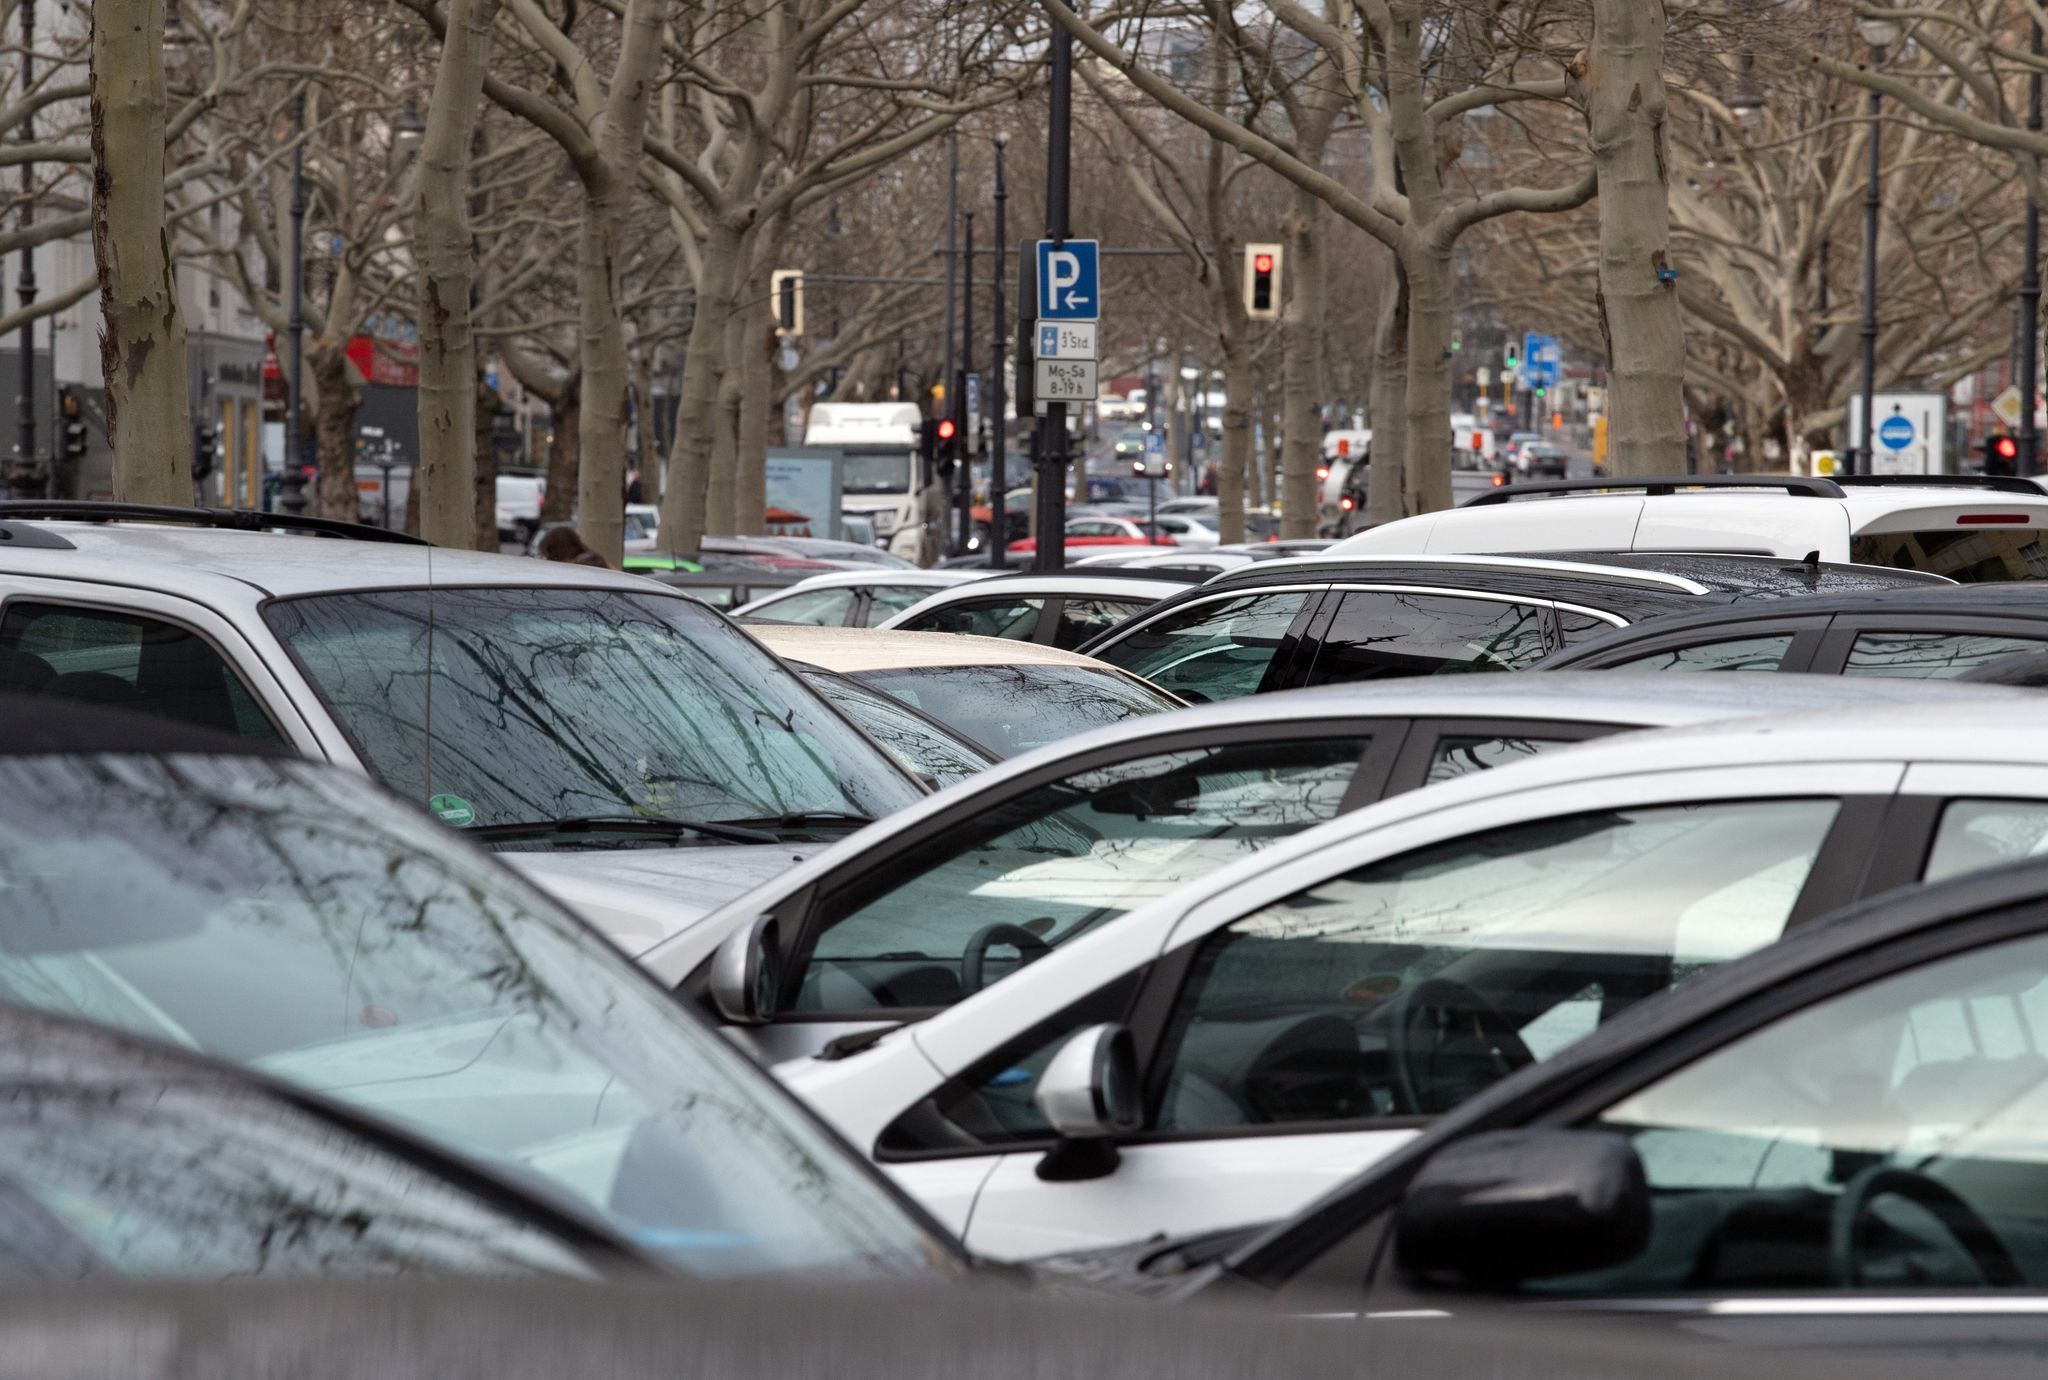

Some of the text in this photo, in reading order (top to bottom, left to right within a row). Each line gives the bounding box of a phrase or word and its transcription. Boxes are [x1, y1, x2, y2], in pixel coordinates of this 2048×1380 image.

[1048, 251, 1080, 310] P
[1048, 364, 1086, 378] Mo-Sa
[1050, 381, 1075, 394] 8-19
